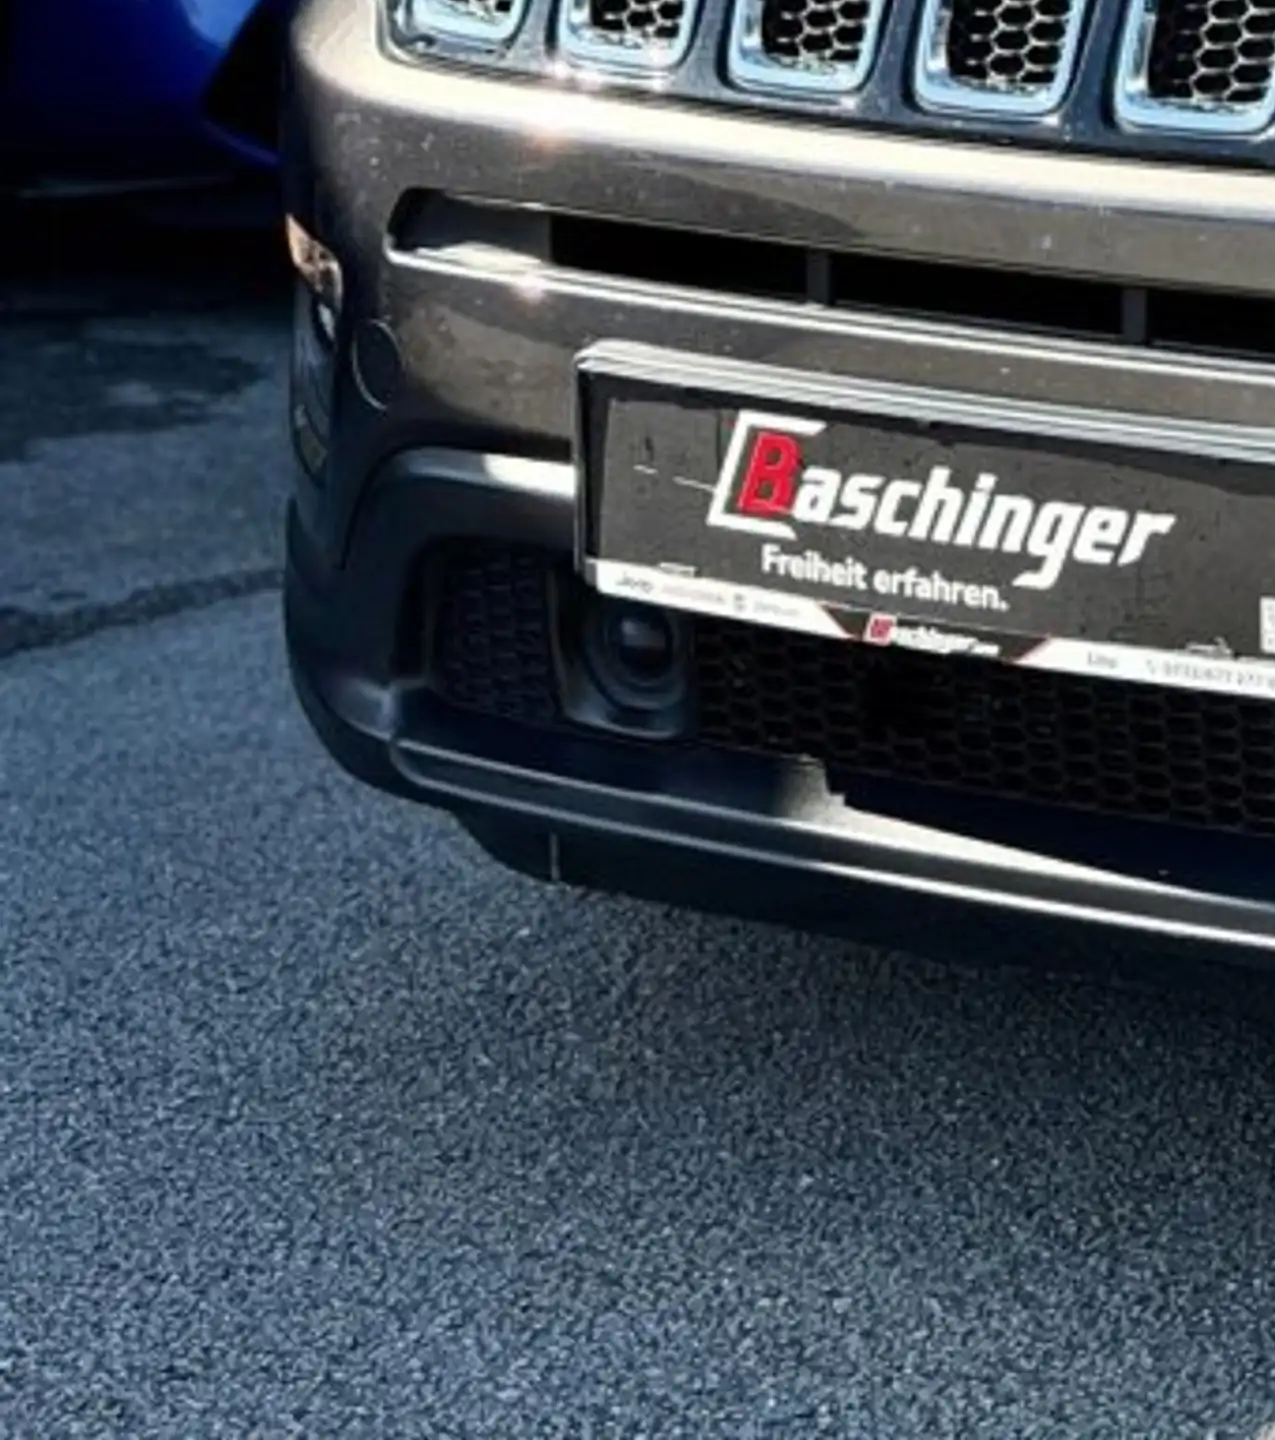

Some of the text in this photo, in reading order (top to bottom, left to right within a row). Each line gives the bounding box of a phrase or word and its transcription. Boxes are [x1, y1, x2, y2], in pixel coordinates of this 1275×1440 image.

[735, 430, 1176, 589] Baschinger
[760, 543, 1009, 612] Freiheit erfahren.
